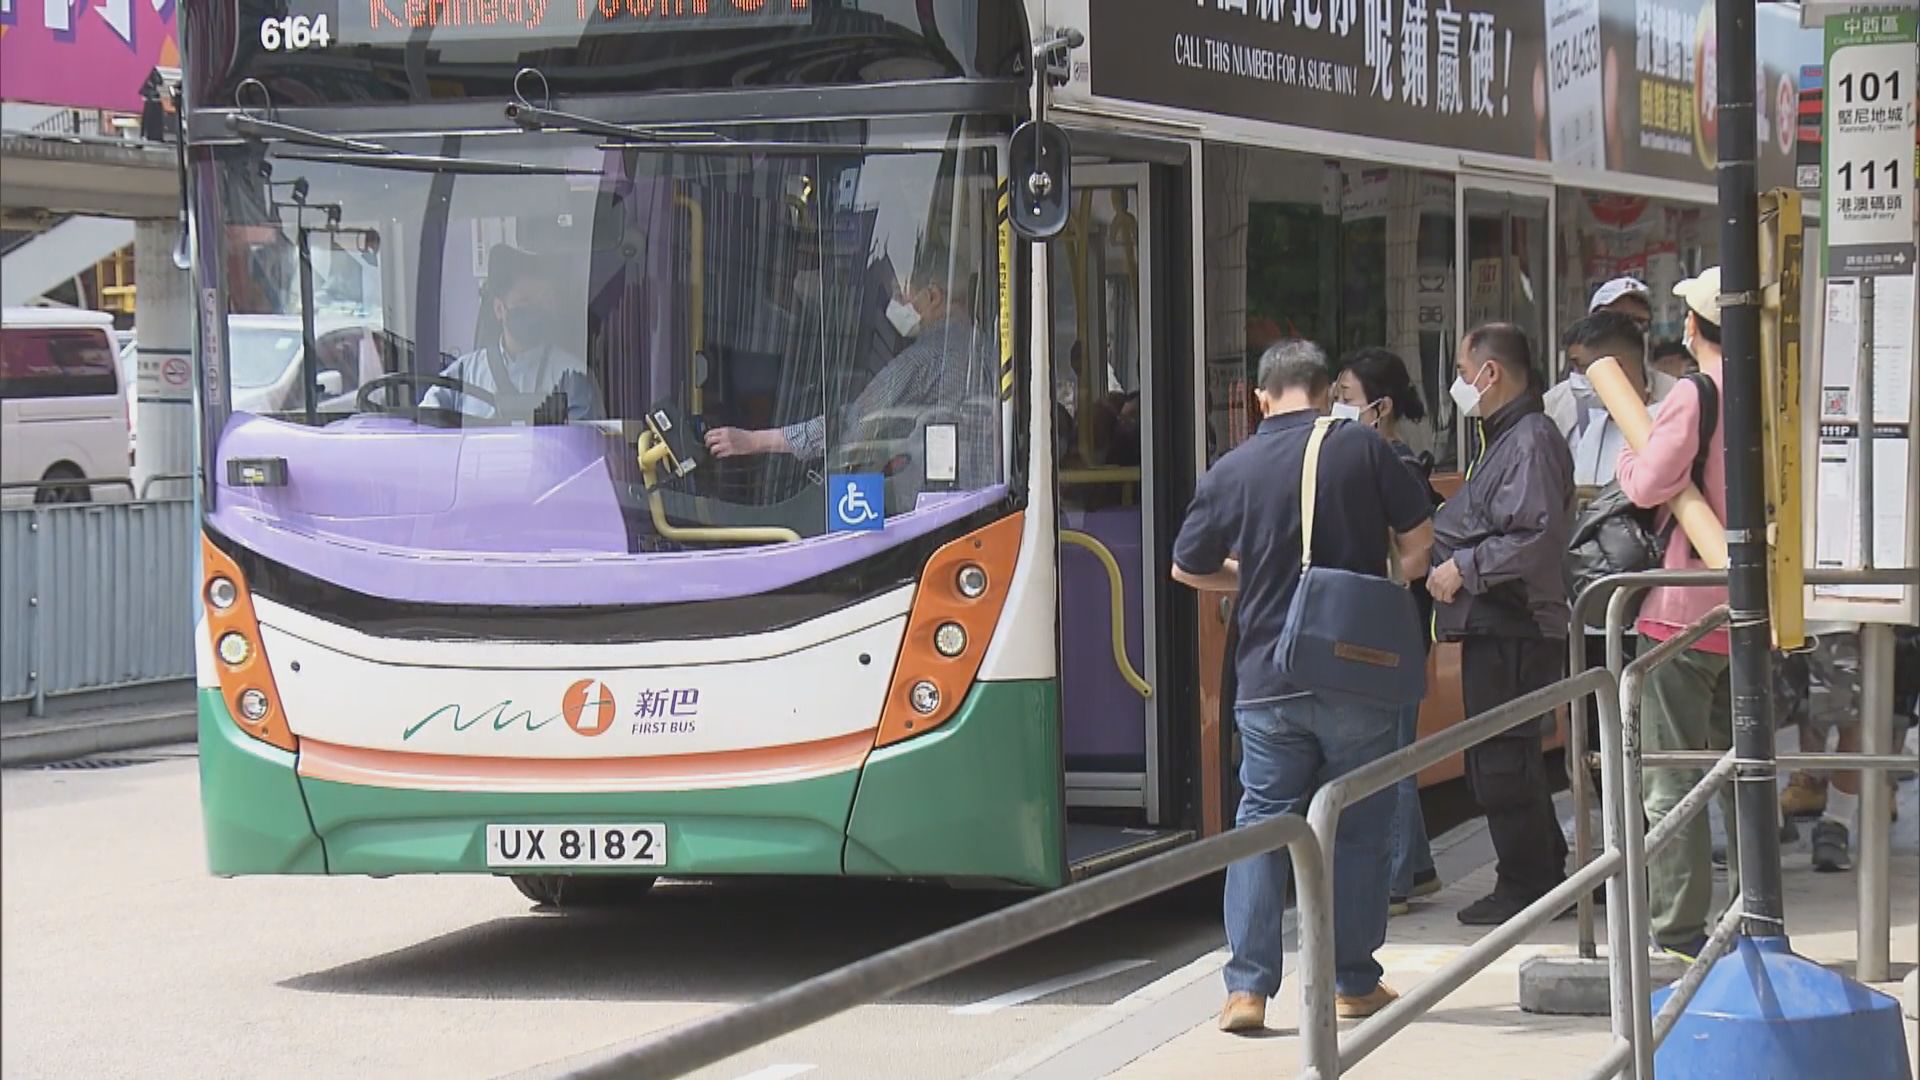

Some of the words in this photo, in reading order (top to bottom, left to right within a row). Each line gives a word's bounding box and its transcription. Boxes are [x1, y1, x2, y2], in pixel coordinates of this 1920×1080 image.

[260, 14, 330, 50] 6164
[1174, 33, 1203, 69] CALL
[1205, 38, 1230, 74] THIS
[1232, 44, 1275, 82] NUMBER
[1277, 53, 1296, 86] FOR
[1299, 57, 1306, 88] A
[1308, 58, 1332, 92] SURE
[1838, 70, 1899, 103] 101
[1838, 107, 1903, 125] 堅尼地城
[1837, 159, 1899, 192] 111
[1837, 195, 1902, 214] 港澳碼頭
[1821, 425, 1850, 436] 111P
[634, 688, 699, 718] 新巴
[632, 721, 667, 735] FIRST
[670, 720, 696, 733] BUS
[499, 830, 546, 860] UX
[559, 829, 654, 860] 8182
